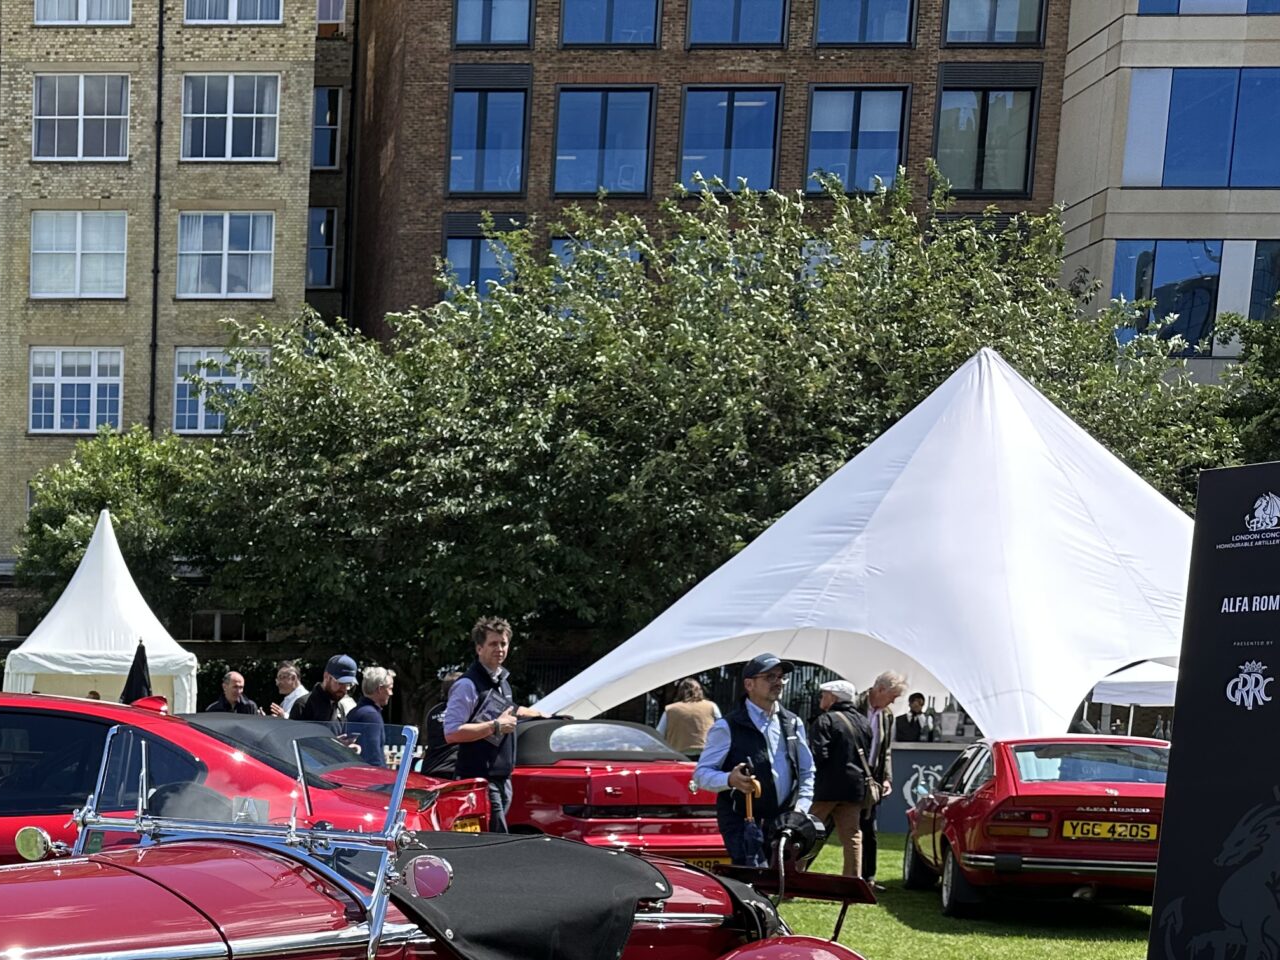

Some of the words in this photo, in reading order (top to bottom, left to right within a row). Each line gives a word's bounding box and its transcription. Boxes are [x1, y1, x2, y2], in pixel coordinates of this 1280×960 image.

[1231, 533, 1260, 542] LONDON
[1261, 531, 1280, 539] CONC
[1215, 541, 1254, 550] HONOURABLE
[1221, 597, 1249, 614] ALFA
[1252, 595, 1280, 612] ROM
[1070, 821, 1102, 836] YGC
[1107, 823, 1151, 838] 420S
